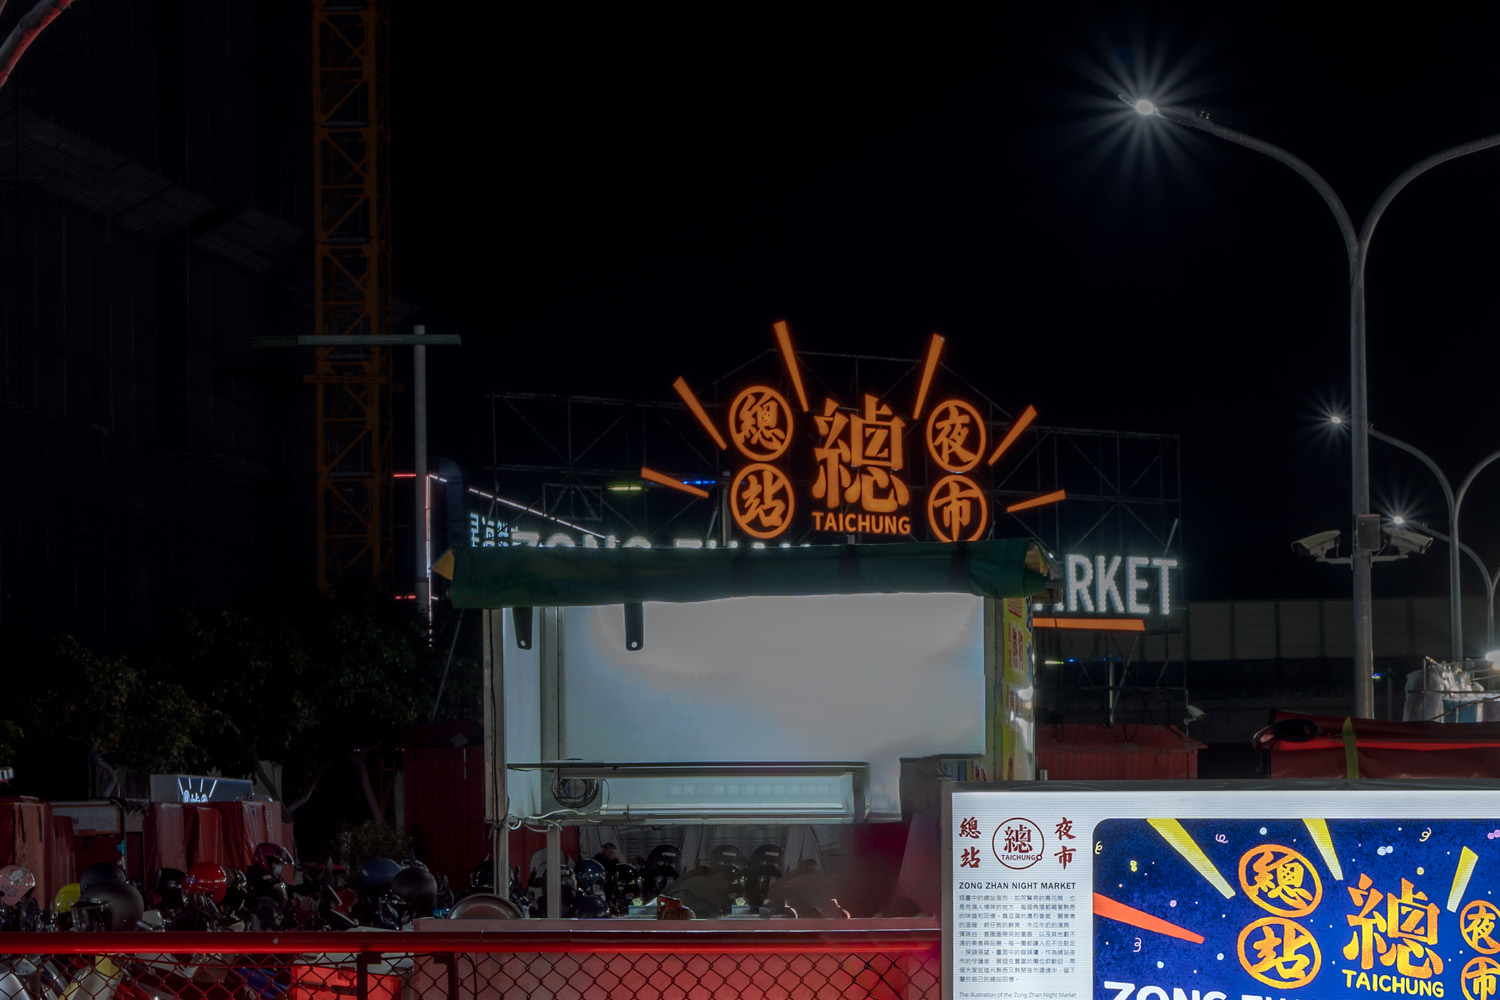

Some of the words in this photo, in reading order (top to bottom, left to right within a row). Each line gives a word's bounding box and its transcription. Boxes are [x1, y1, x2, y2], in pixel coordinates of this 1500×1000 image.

[931, 404, 981, 541] 夜市
[811, 511, 911, 535] TAICHUNG
[958, 816, 981, 869] 總站
[1054, 816, 1077, 870] 夜市
[958, 882, 983, 890] ZONG
[985, 882, 1009, 890] ZHAN
[1011, 882, 1038, 890] NIGHT
[1040, 882, 1077, 890] MARKET
[1342, 968, 1445, 999] TAICHUNG
